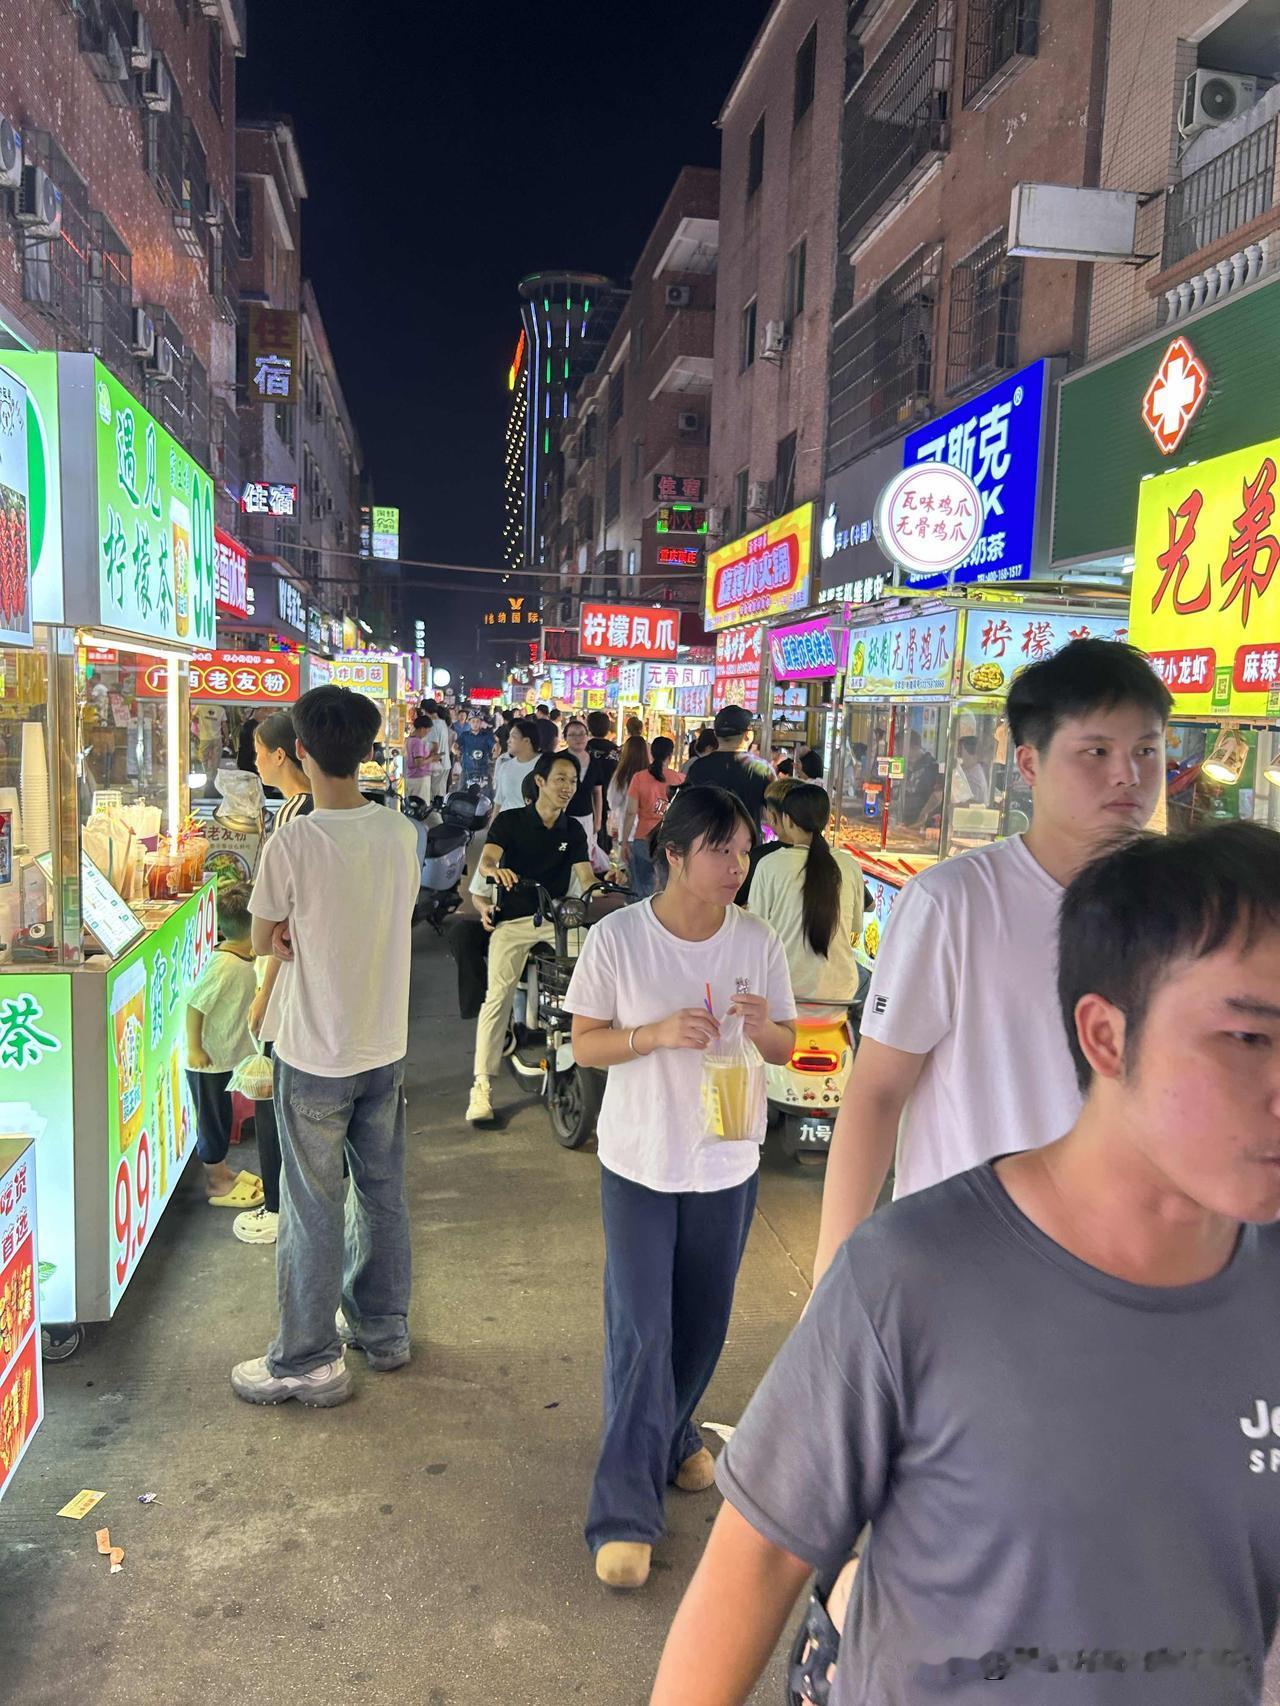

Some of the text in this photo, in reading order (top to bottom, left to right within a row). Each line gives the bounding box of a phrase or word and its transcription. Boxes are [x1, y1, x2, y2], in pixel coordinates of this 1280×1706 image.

[116, 408, 161, 519] 遇见
[658, 477, 700, 496] 住宿
[244, 484, 294, 515] 住宿
[192, 468, 213, 640] 9.9
[896, 516, 967, 542] 无骨鸡爪
[1152, 457, 1280, 629] 兄弟
[103, 505, 173, 630] 柠檬茶
[584, 612, 676, 651] 柠檬凤爪
[649, 666, 712, 686] 无骨凤爪
[1243, 651, 1280, 683] 麻辣
[194, 884, 214, 978] 9.9
[0, 996, 57, 1067] 茶
[800, 1125, 832, 1142] 九号
[114, 1132, 150, 1287] 9.9
